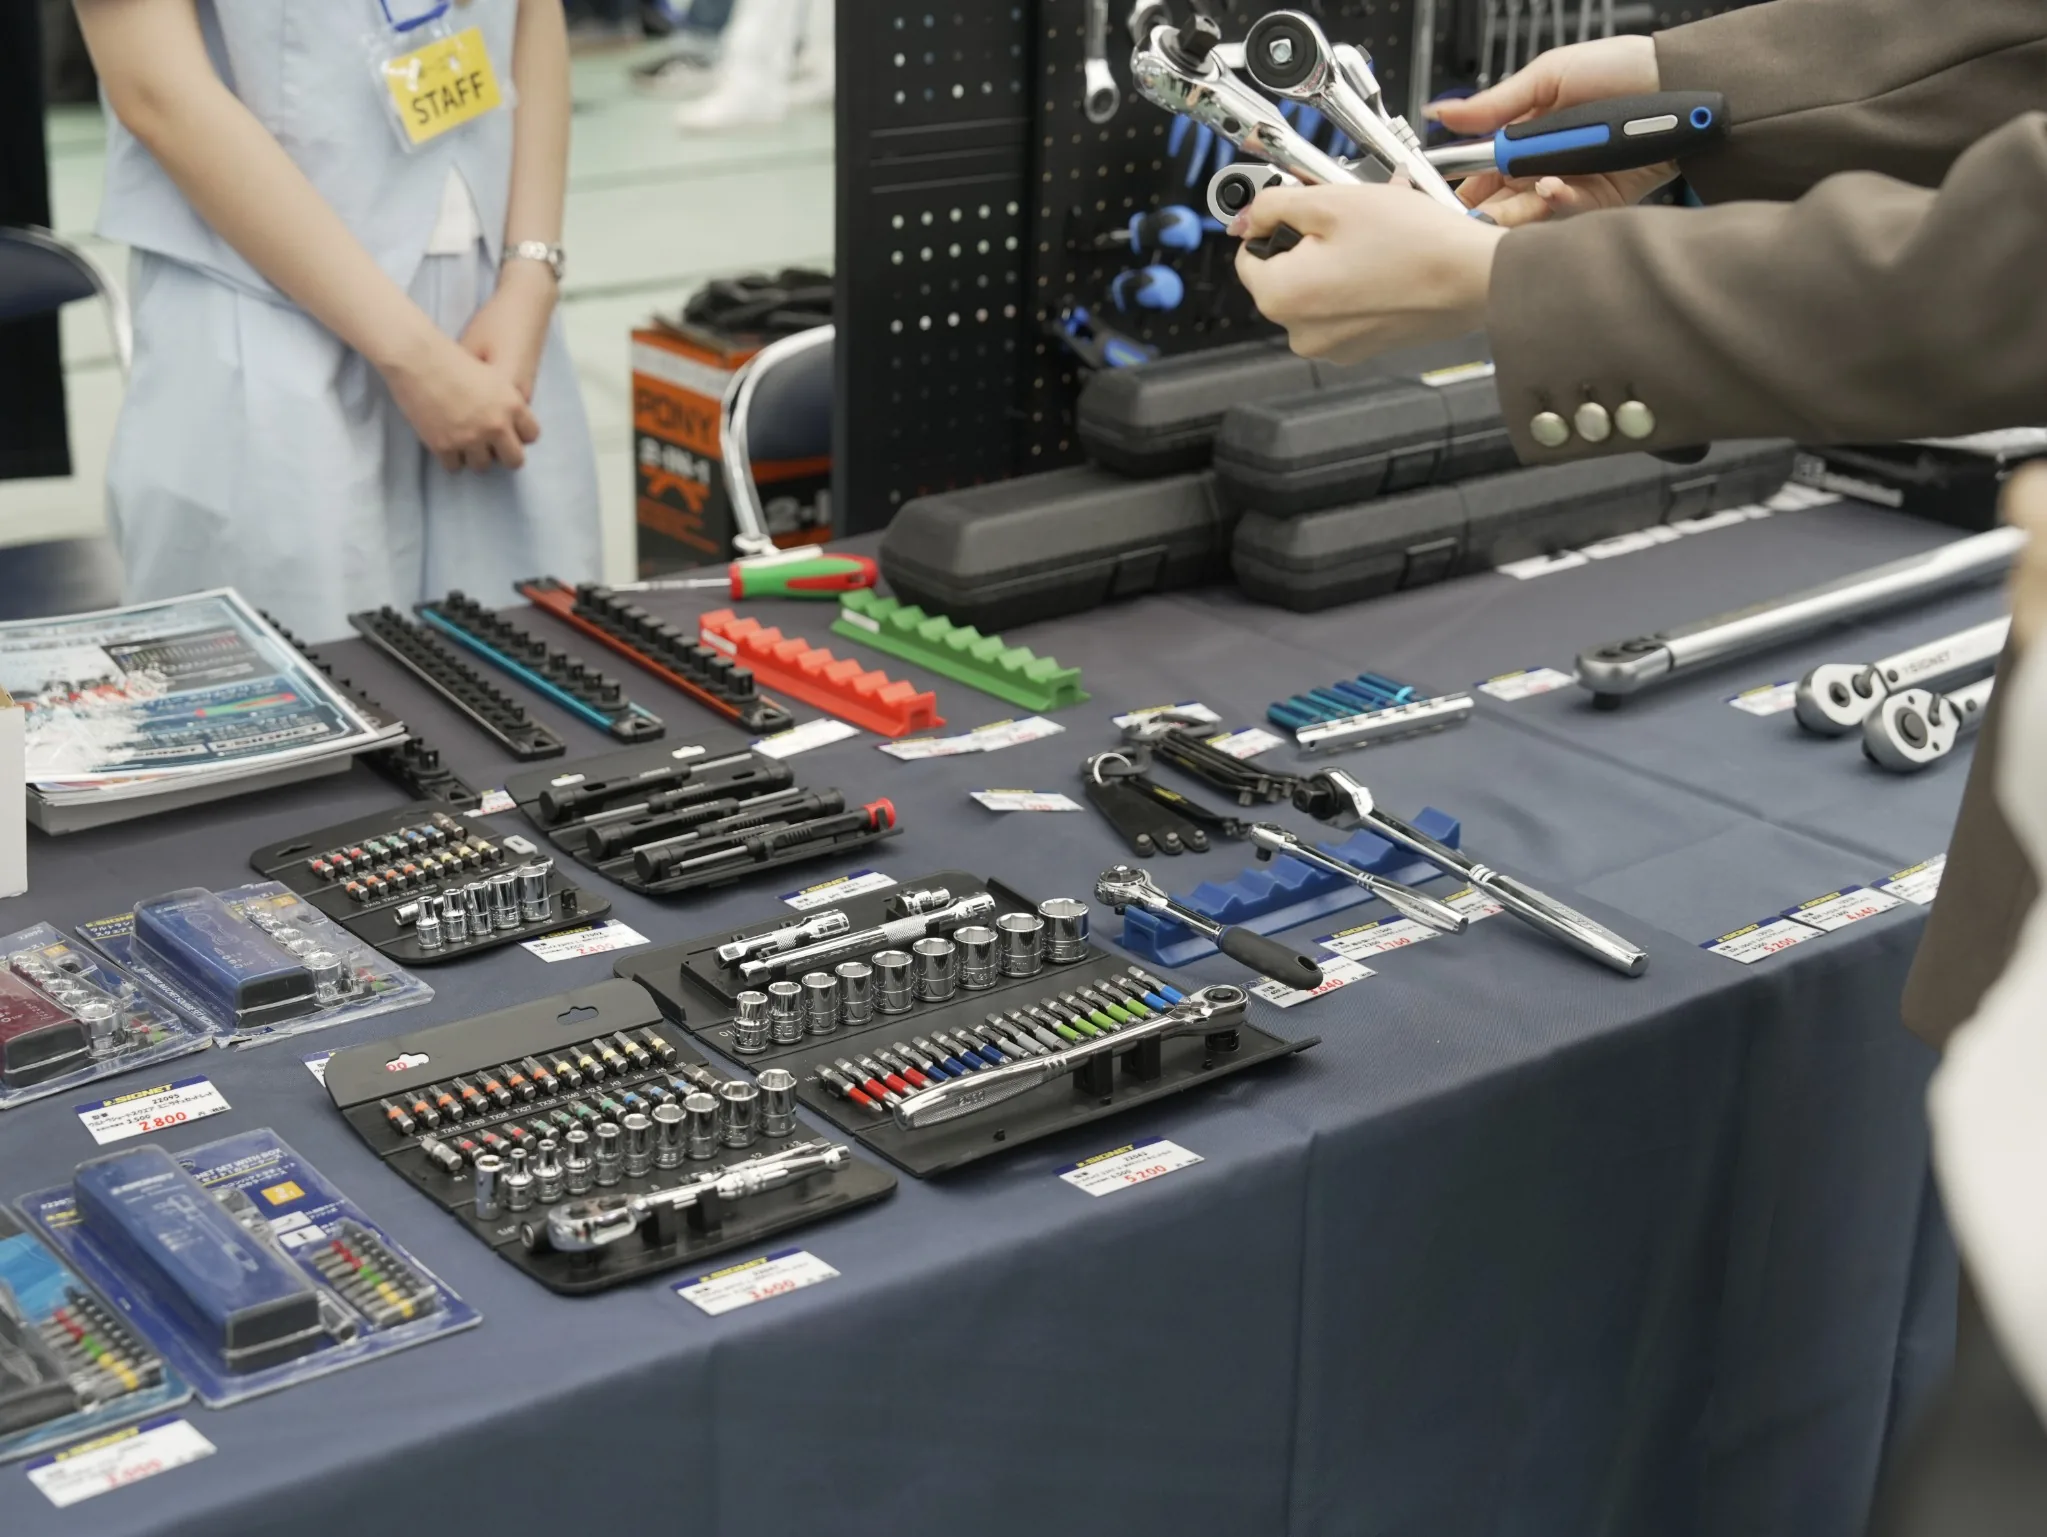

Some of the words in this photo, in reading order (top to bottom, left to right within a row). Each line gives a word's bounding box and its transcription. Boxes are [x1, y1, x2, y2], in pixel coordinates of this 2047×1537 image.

[411, 71, 485, 125] STAFF
[113, 1084, 173, 1103] SIGNET
[441, 1125, 462, 1134] TX15
[465, 1118, 485, 1128] TX20
[513, 1105, 532, 1114] TX27
[536, 1098, 557, 1107] TX30
